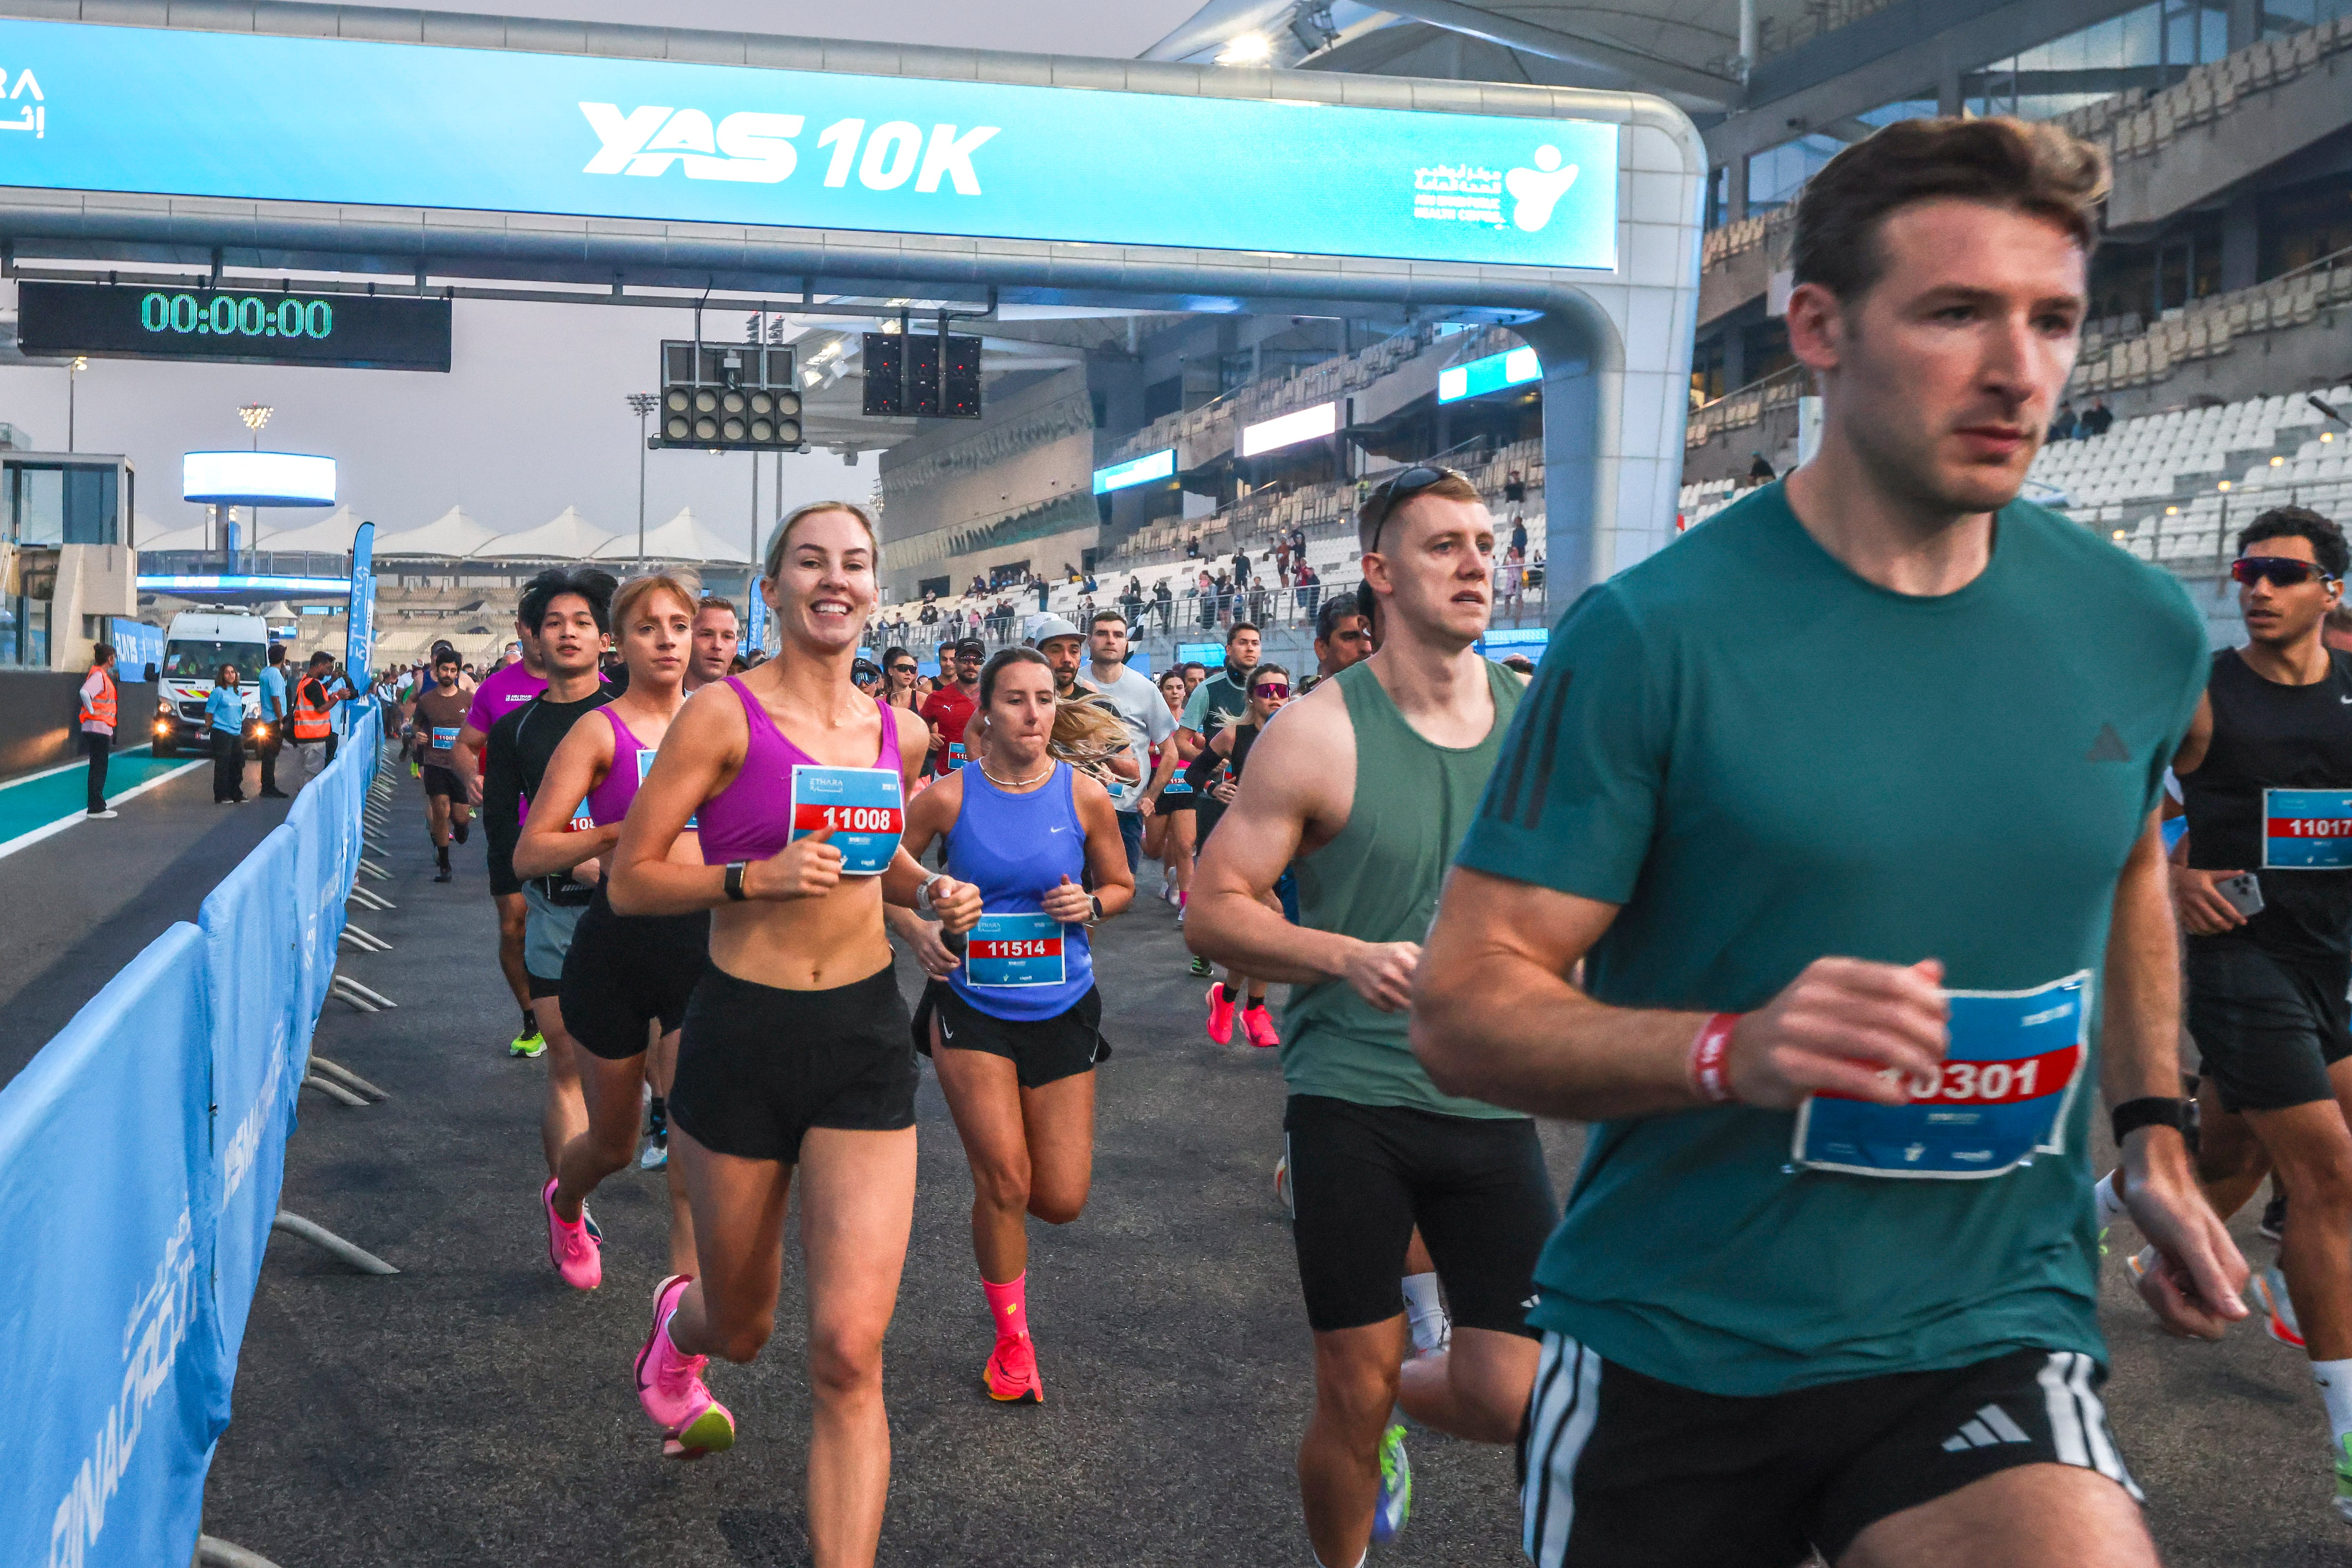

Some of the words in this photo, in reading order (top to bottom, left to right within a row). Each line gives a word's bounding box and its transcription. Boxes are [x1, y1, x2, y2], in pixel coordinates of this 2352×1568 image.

[579, 102, 805, 183] YAS
[817, 118, 1001, 195] 10K
[142, 293, 333, 339] 00:00:00
[823, 807, 890, 831] 11008
[2290, 819, 2352, 836] 11017
[988, 940, 1045, 956] 11514
